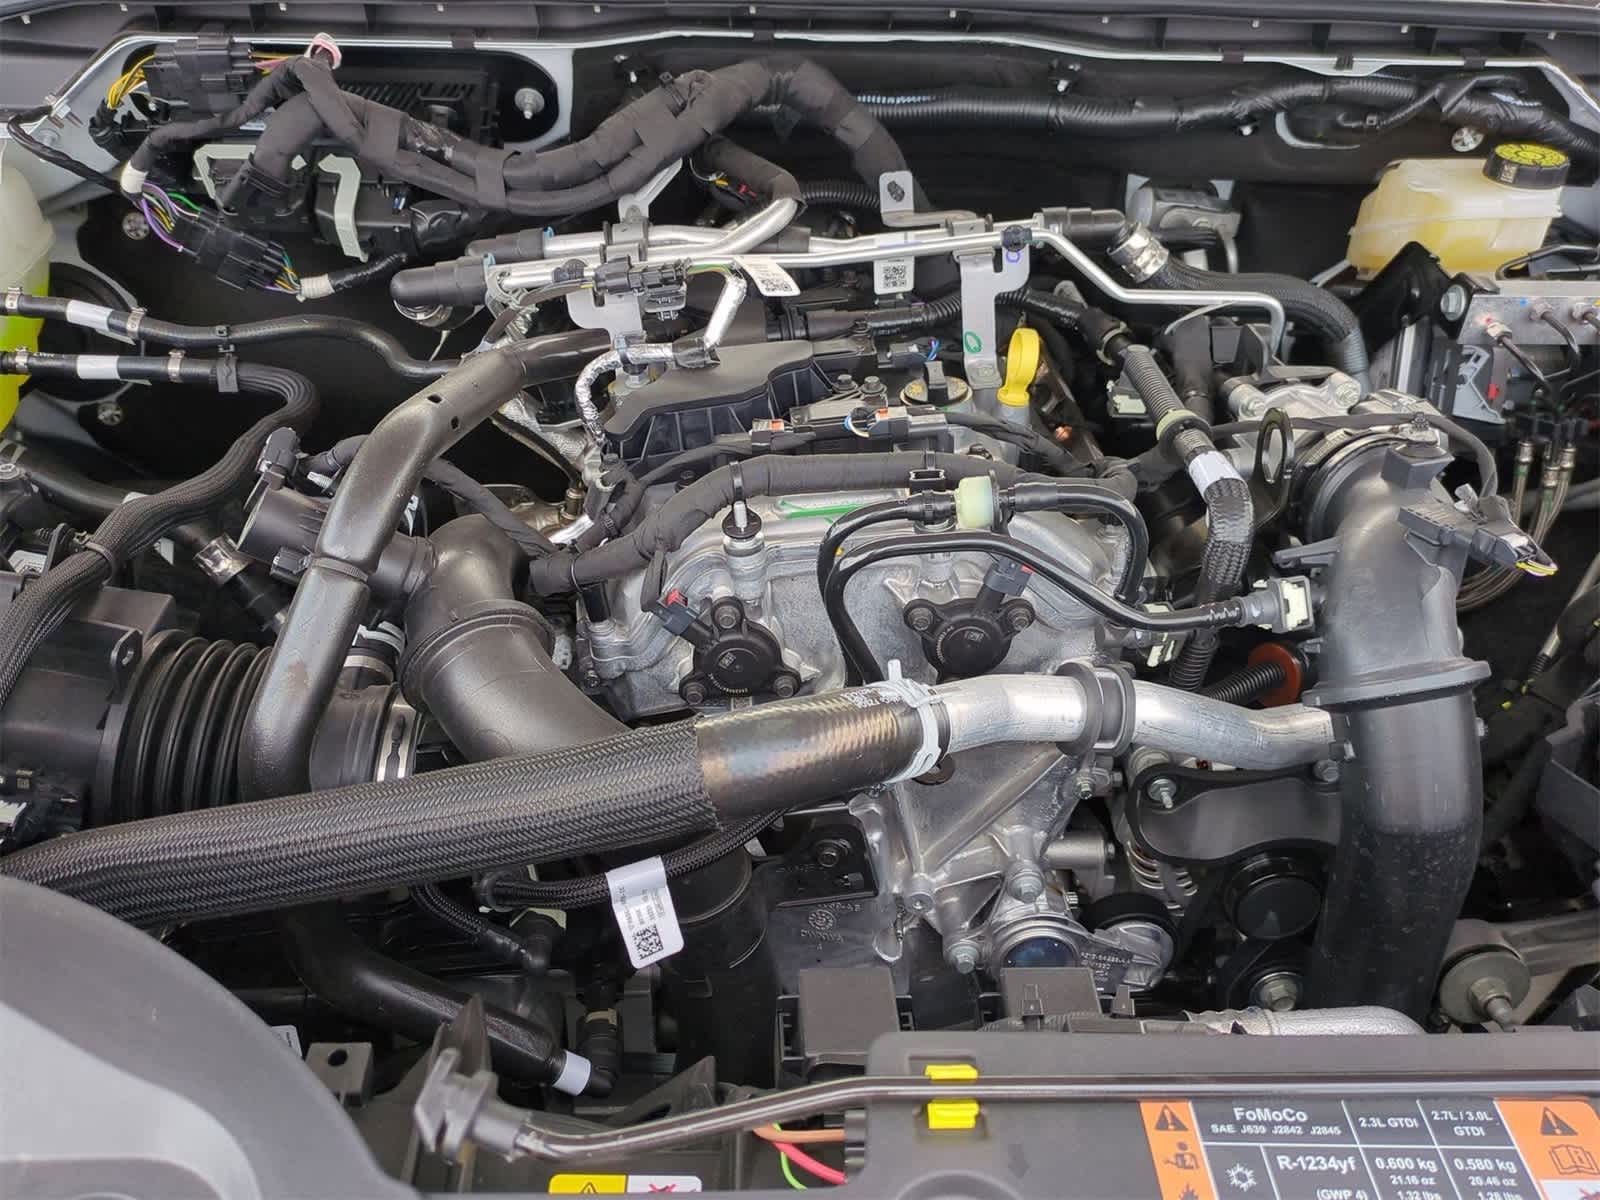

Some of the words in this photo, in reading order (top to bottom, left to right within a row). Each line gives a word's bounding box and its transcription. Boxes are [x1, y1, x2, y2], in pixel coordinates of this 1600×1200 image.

[1233, 1107, 1309, 1122] FoMoCo
[1210, 1123, 1237, 1134] SAE
[1358, 1117, 1387, 1128] 2.3L
[1453, 1125, 1486, 1137] GTDI
[1276, 1155, 1356, 1175] R-1234yf
[1375, 1156, 1415, 1170] 0.600
[1416, 1157, 1439, 1173] kg
[1453, 1157, 1493, 1171] 0.580
[1495, 1158, 1518, 1174] kg
[1420, 1176, 1437, 1186] oz
[1502, 1178, 1519, 1187] oz
